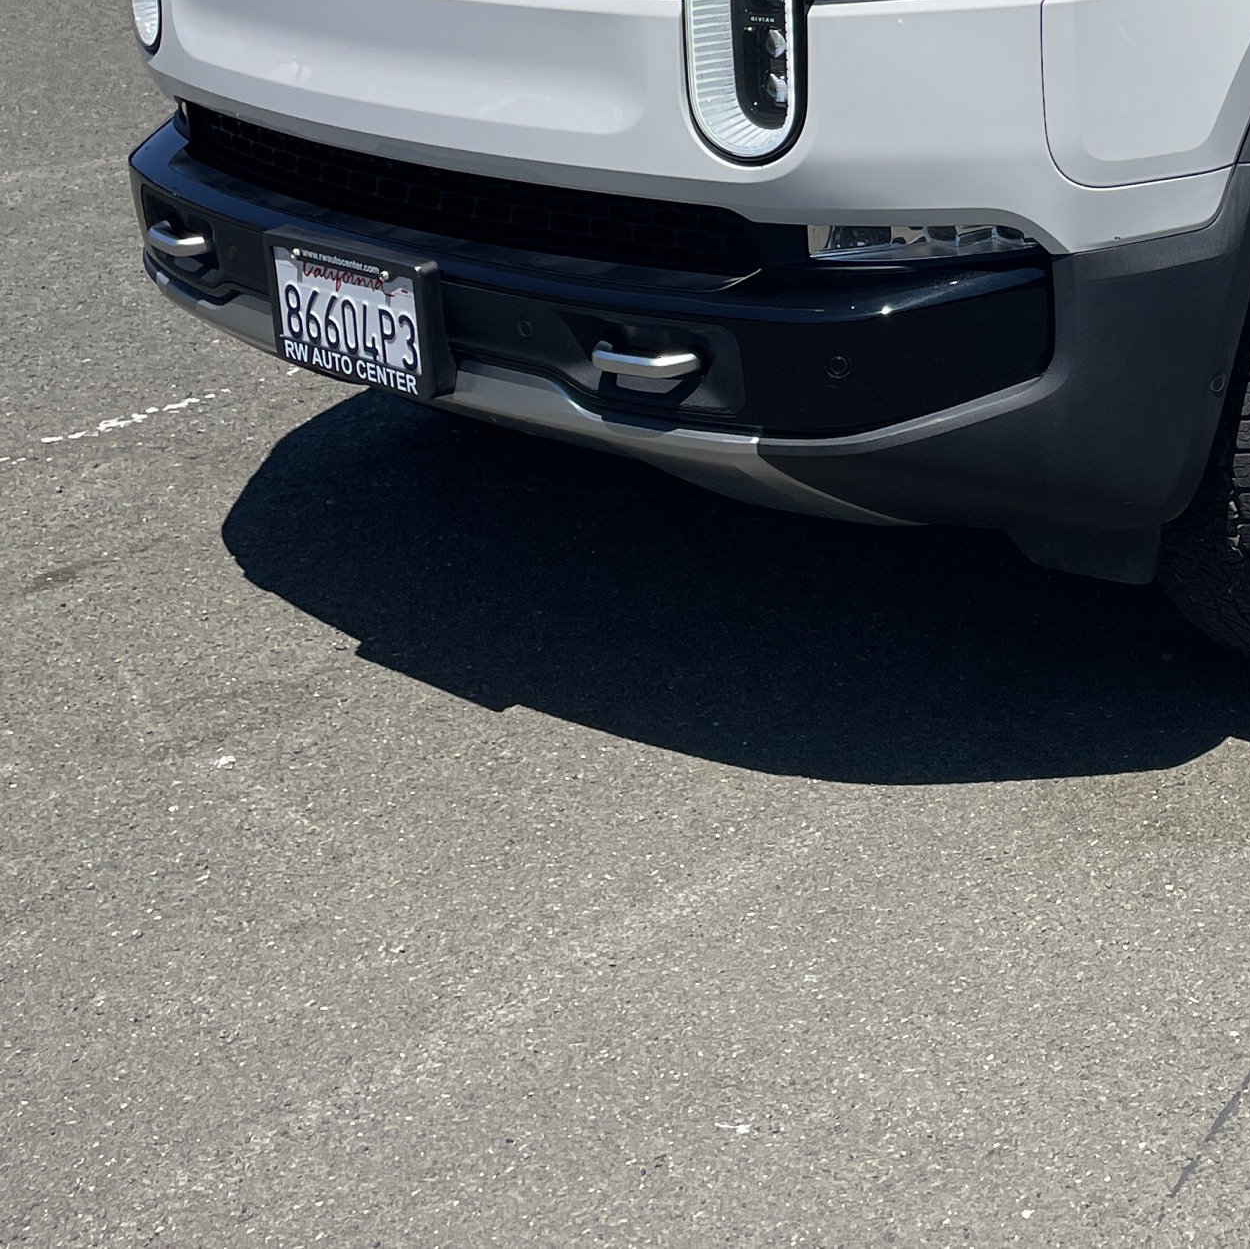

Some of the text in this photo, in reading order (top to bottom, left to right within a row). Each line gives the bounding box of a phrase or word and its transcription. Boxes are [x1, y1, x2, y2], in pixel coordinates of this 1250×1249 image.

[302, 250, 380, 274] www.rwautocenter.com
[285, 284, 418, 371] 86604P3
[284, 340, 418, 395] RW AUTO CENTER
